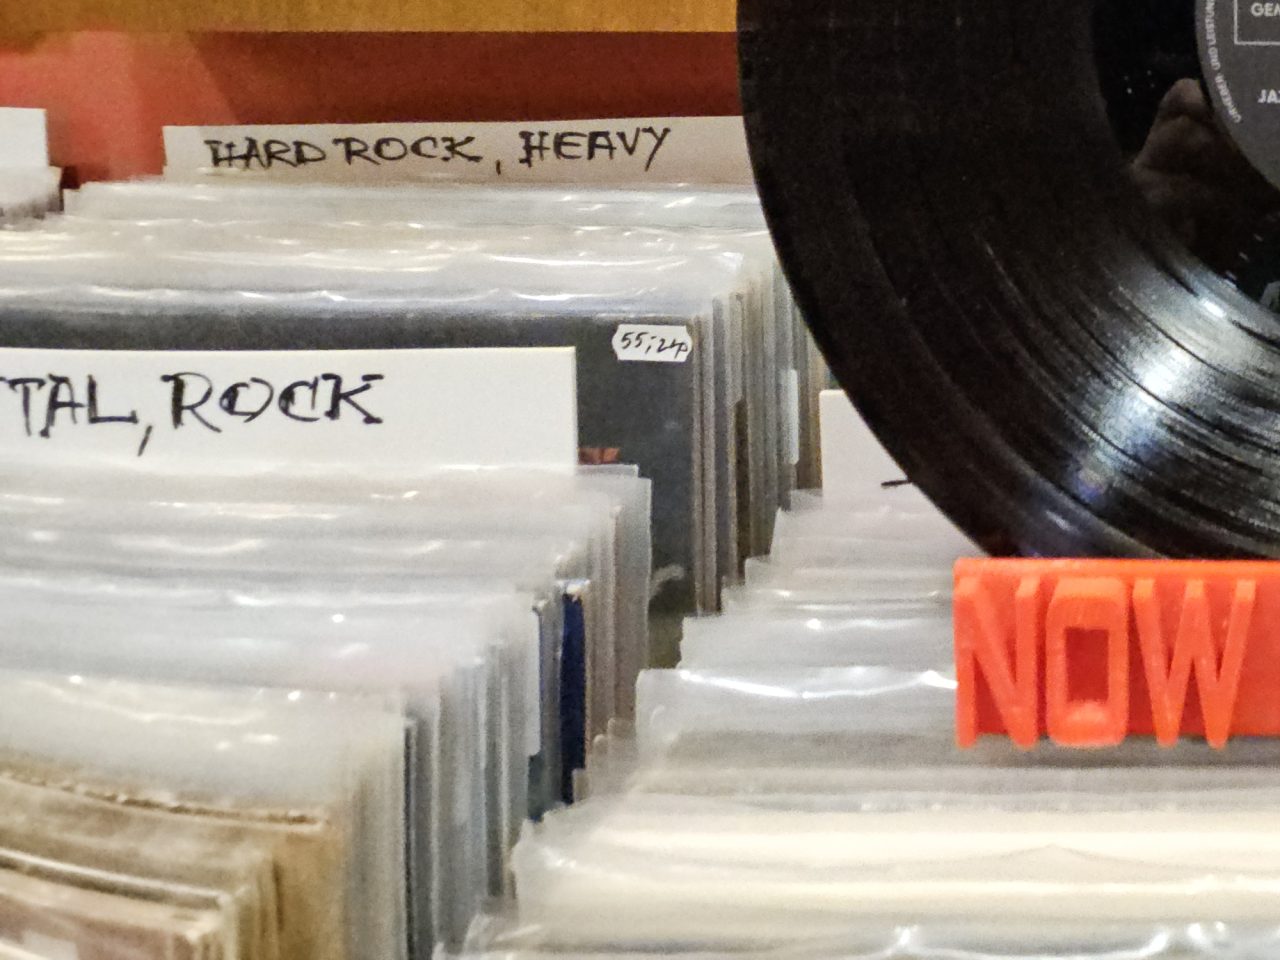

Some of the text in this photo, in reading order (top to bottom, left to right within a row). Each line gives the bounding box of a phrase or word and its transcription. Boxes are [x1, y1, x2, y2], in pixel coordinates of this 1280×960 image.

[204, 136, 327, 170] HARD
[517, 125, 673, 173] HEAVY
[0, 371, 385, 457] TAL, ROCK
[953, 577, 1257, 749] NOW
